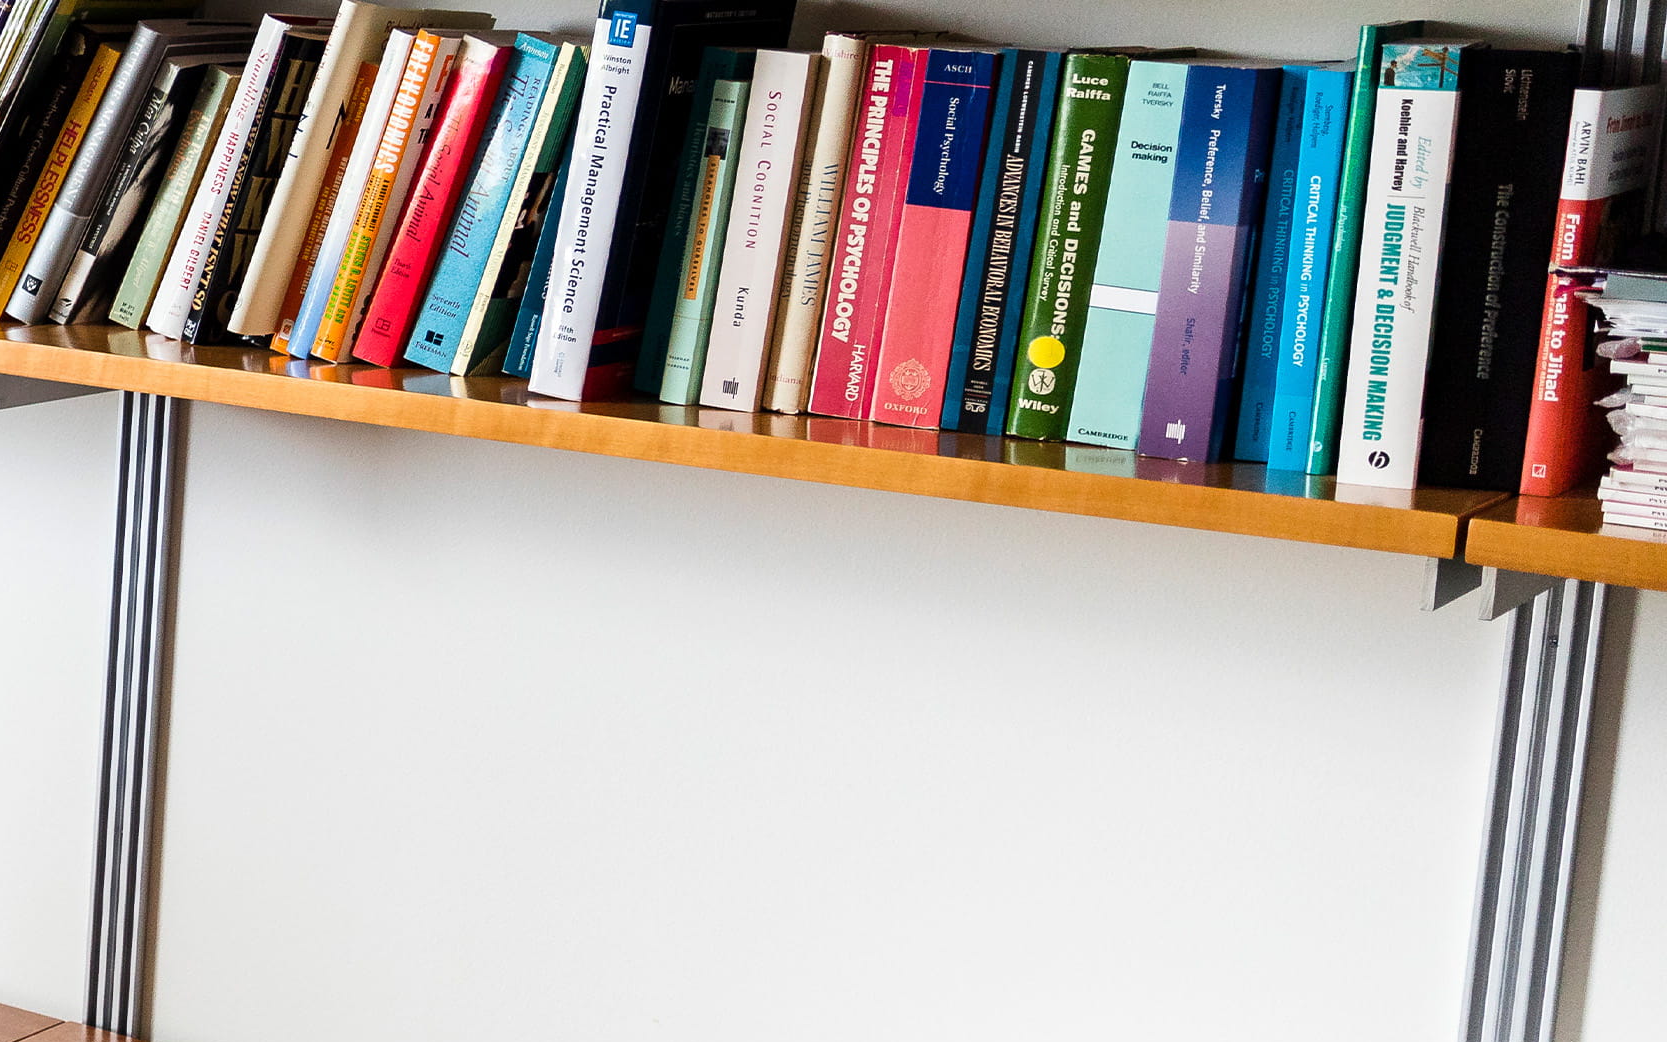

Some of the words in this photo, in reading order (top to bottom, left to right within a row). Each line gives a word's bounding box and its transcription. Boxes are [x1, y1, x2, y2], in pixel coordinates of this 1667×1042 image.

[614, 18, 631, 39] IE
[601, 64, 630, 75] Albright
[604, 53, 632, 65] Winston
[870, 57, 893, 94] THE
[944, 63, 973, 74] ASCH
[233, 48, 272, 122] Stumbling
[1067, 88, 1111, 101] Raiffa
[1072, 73, 1109, 87] Luce
[1148, 90, 1172, 98] RAIFFA
[1502, 67, 1516, 93] Slovic
[1516, 68, 1532, 120] Lichtenstein
[142, 92, 164, 120] Mea
[373, 37, 435, 173] FREAKONOMICS
[513, 77, 542, 138] READINGS
[592, 83, 619, 150] Practical
[759, 89, 781, 149] SOCIAL
[944, 96, 961, 131] Social
[1142, 98, 1174, 108] TVERSKY
[1210, 83, 1225, 119] Tversky
[1398, 98, 1413, 136] Koehler
[124, 119, 151, 155] Culpa
[854, 94, 888, 194] PRINCIPLES
[1131, 140, 1173, 153] Decision
[1396, 138, 1408, 157] and
[1413, 136, 1432, 172] Edited
[1577, 120, 1592, 155] ARVIN
[209, 131, 240, 195] HAPPINESS
[499, 144, 519, 183] ABOUT
[800, 158, 815, 186] and
[931, 131, 956, 196] Psychology
[1072, 128, 1096, 196] GAMES
[1132, 151, 1168, 164] making
[1201, 128, 1221, 187] Preference,
[1391, 158, 1407, 191] Harvey
[1574, 157, 1587, 187] BAHL
[16, 118, 82, 246] HELPLESSNESS
[226, 153, 249, 201] KNOW
[700, 162, 716, 216] STRANGERS
[998, 154, 1025, 215] ADVANCES
[1052, 164, 1071, 216] Introduction
[1277, 168, 1294, 217] CRITICAL
[1411, 176, 1427, 189] by
[1498, 181, 1513, 207] The
[324, 191, 337, 213] PEOPLE
[570, 153, 605, 254] Management
[744, 158, 771, 250] COGNITION
[810, 161, 838, 244] WILLIAM
[850, 195, 872, 223] OF
[1066, 200, 1084, 232] and
[1197, 189, 1213, 223] Belief,
[1305, 175, 1322, 224] CRITICAL
[191, 210, 214, 247] DANIEL
[211, 200, 234, 247] WHAT
[697, 222, 705, 234] TO
[997, 214, 1015, 228] IN
[1050, 217, 1062, 237] and
[1195, 224, 1208, 243] and
[1408, 206, 1428, 252] Blackwell
[1560, 213, 1580, 260] From
[351, 234, 372, 267] STEVEN
[779, 190, 811, 301] Phenomenology
[1044, 238, 1059, 269] Critical
[1270, 219, 1287, 273] THINKING
[1299, 226, 1317, 281] THINKING
[1378, 203, 1406, 284] JUDGMENT
[1485, 208, 1513, 292] Construction
[176, 248, 202, 291] GILBERT
[687, 239, 702, 292] OURSELVES
[798, 249, 823, 307] JAMES
[829, 223, 867, 343] PSYCHOLOGY
[984, 229, 1013, 305] BEHAVIORAL
[1187, 244, 1206, 295] Similarity
[1402, 253, 1421, 300] Handbook
[190, 289, 206, 311] SO
[339, 277, 358, 307] LEVITT
[433, 294, 461, 310] Seventh
[560, 257, 585, 315] Science
[1038, 270, 1053, 302] Survey
[1299, 282, 1310, 291] in
[1376, 287, 1394, 300] &
[1485, 292, 1500, 307] of
[429, 303, 456, 318] Edition
[731, 285, 749, 328] Kunda
[1260, 286, 1279, 358] PSYCHOLOGY
[1399, 299, 1415, 313] of
[972, 305, 1000, 372] ECONOMICS
[1290, 294, 1311, 366] PSYCHOLOGY
[1368, 302, 1395, 376] DECISION
[1474, 308, 1499, 380] Preference
[1549, 328, 1565, 348] to
[844, 343, 866, 401] HARVARD
[1542, 352, 1563, 401] Jihad
[884, 401, 928, 415] OXFORD
[1018, 397, 1060, 415] Wiley
[1362, 379, 1387, 441] MAKING
[1078, 427, 1129, 441] CAMBRIDGE
